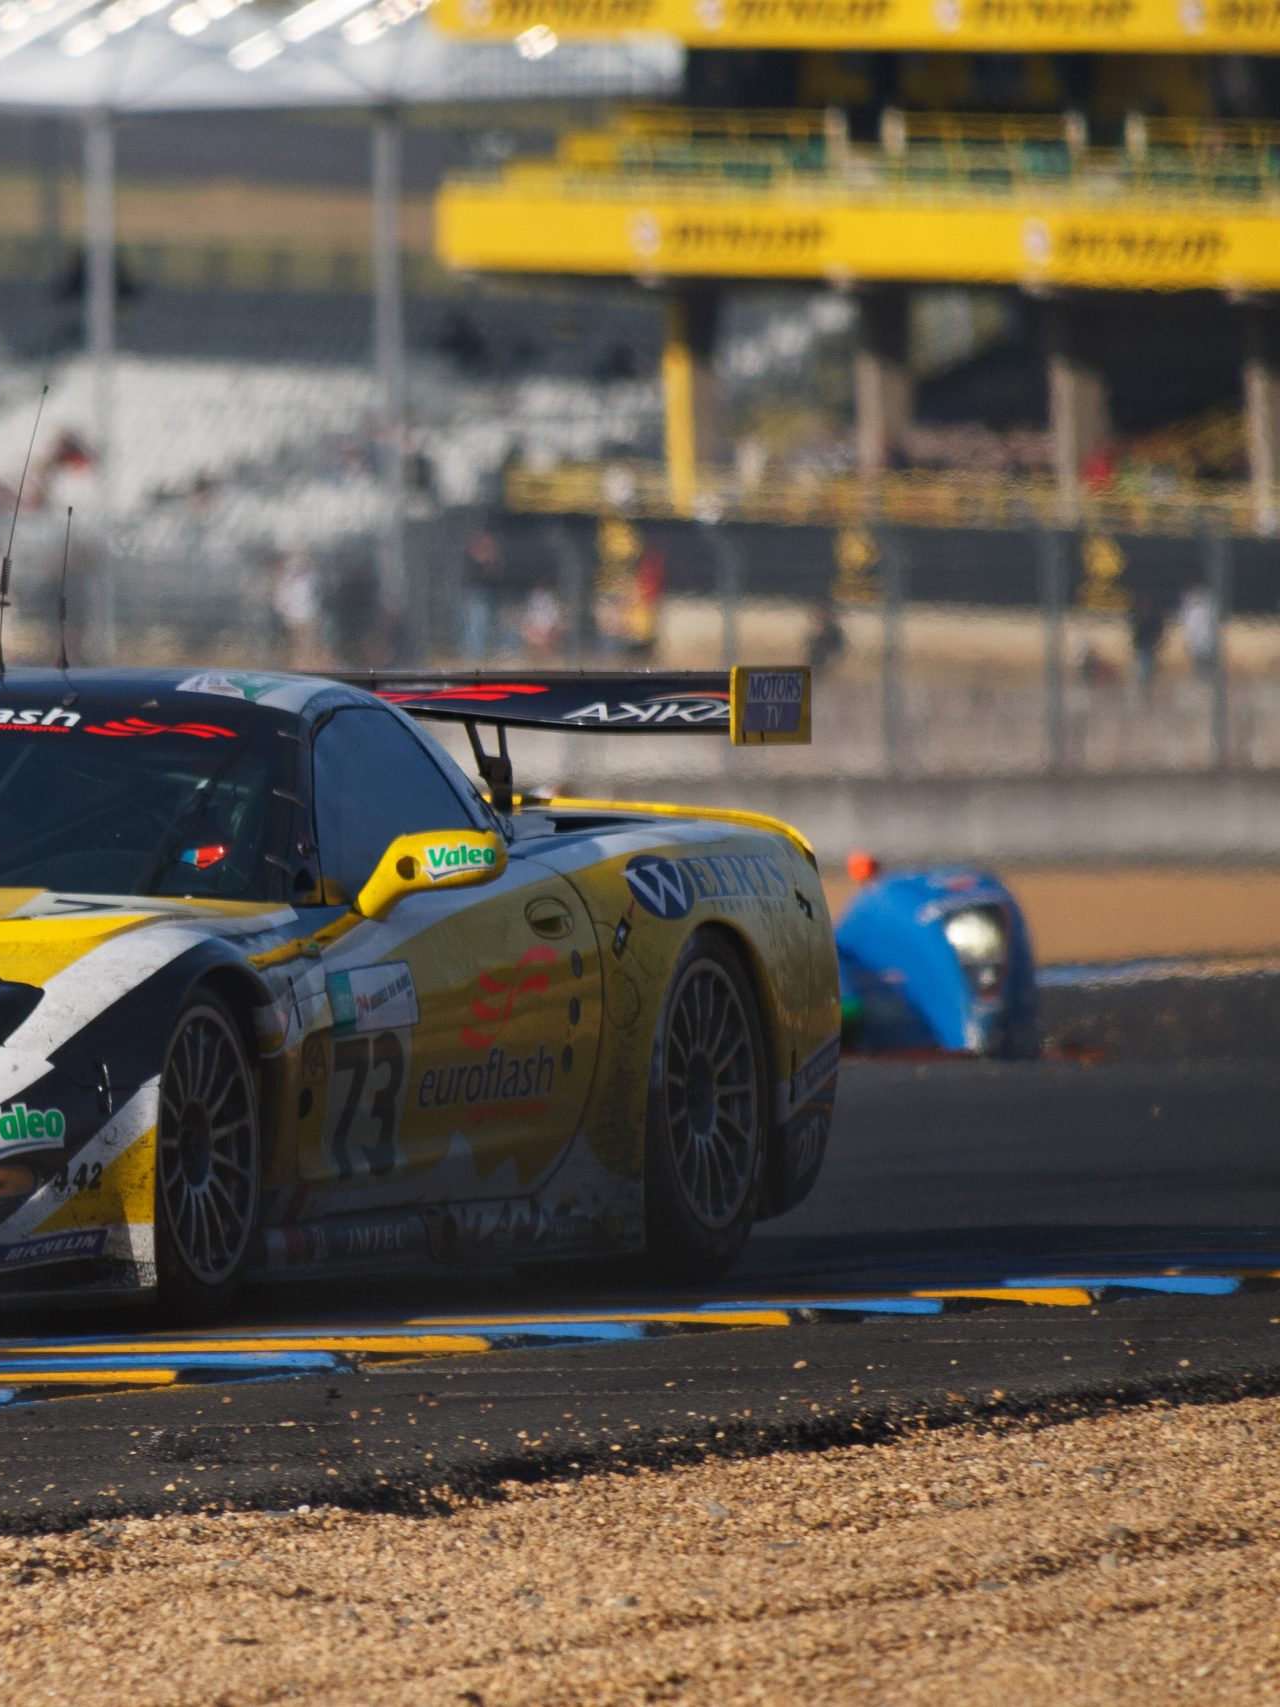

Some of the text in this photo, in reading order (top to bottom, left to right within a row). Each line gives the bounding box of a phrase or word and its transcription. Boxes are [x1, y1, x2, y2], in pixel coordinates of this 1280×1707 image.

[749, 674, 802, 700] MOTORS
[765, 705, 782, 729] TV
[428, 844, 496, 868] Valeo
[622, 856, 787, 916] WEERTS
[418, 1045, 555, 1108] euroflash
[332, 1030, 405, 1181] 73
[4, 1234, 100, 1262] MICHELIN
